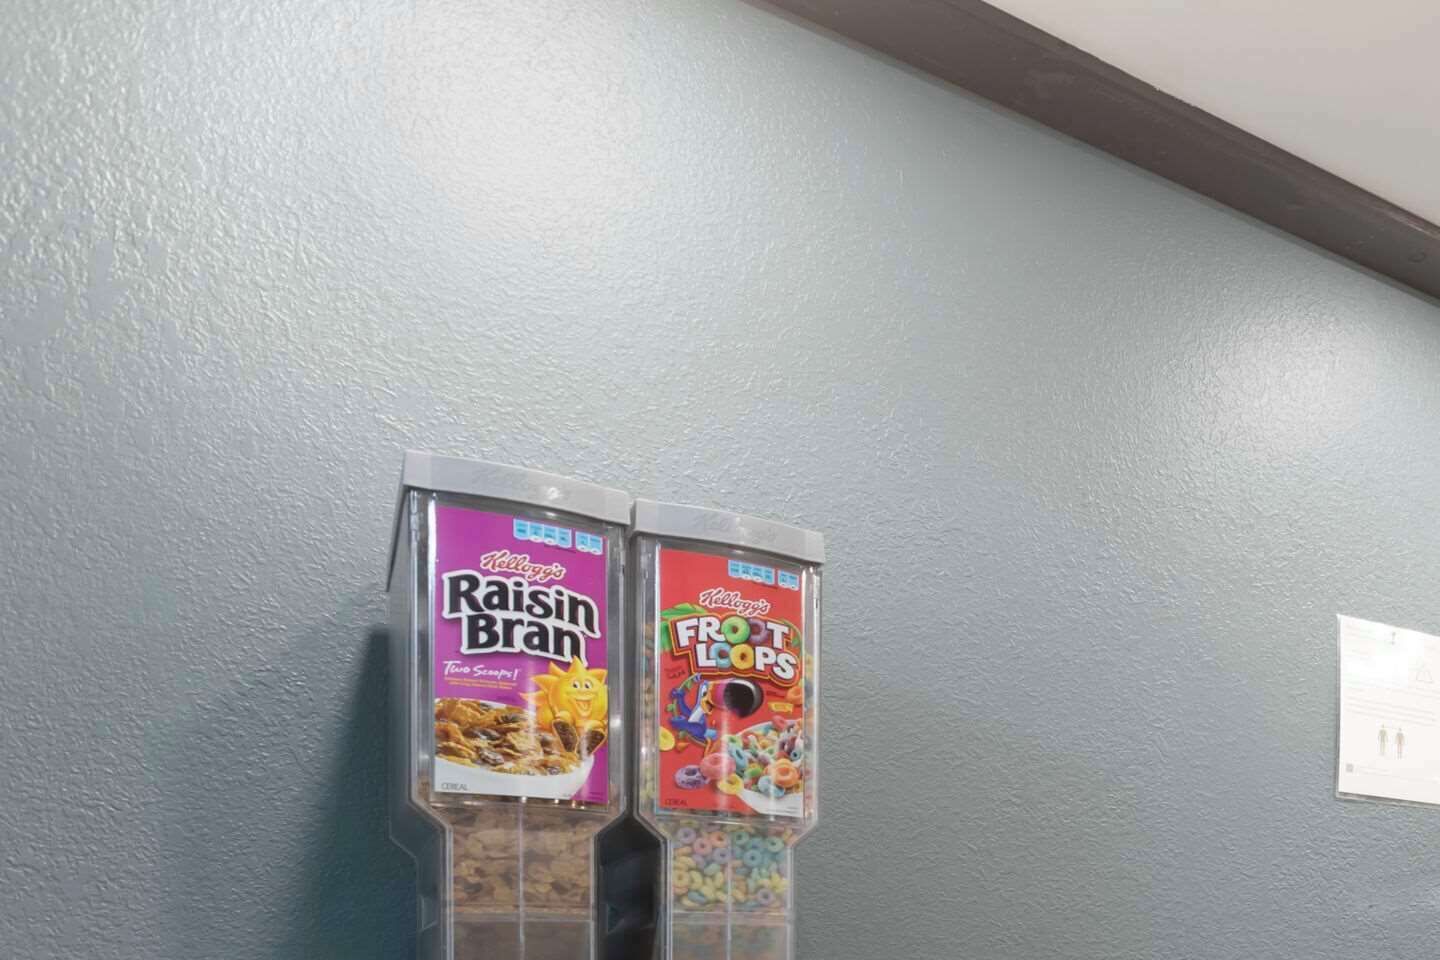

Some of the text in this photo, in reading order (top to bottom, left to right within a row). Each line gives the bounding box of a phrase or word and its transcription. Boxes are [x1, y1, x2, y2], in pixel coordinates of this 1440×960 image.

[481, 550, 566, 581] Kellogg's
[445, 572, 599, 636] Raisin
[700, 587, 771, 616] Kellogg's
[463, 612, 585, 661] Bran
[675, 615, 789, 649] FROOT
[442, 661, 519, 681] Two Scoops!
[695, 642, 798, 681] LOOPS
